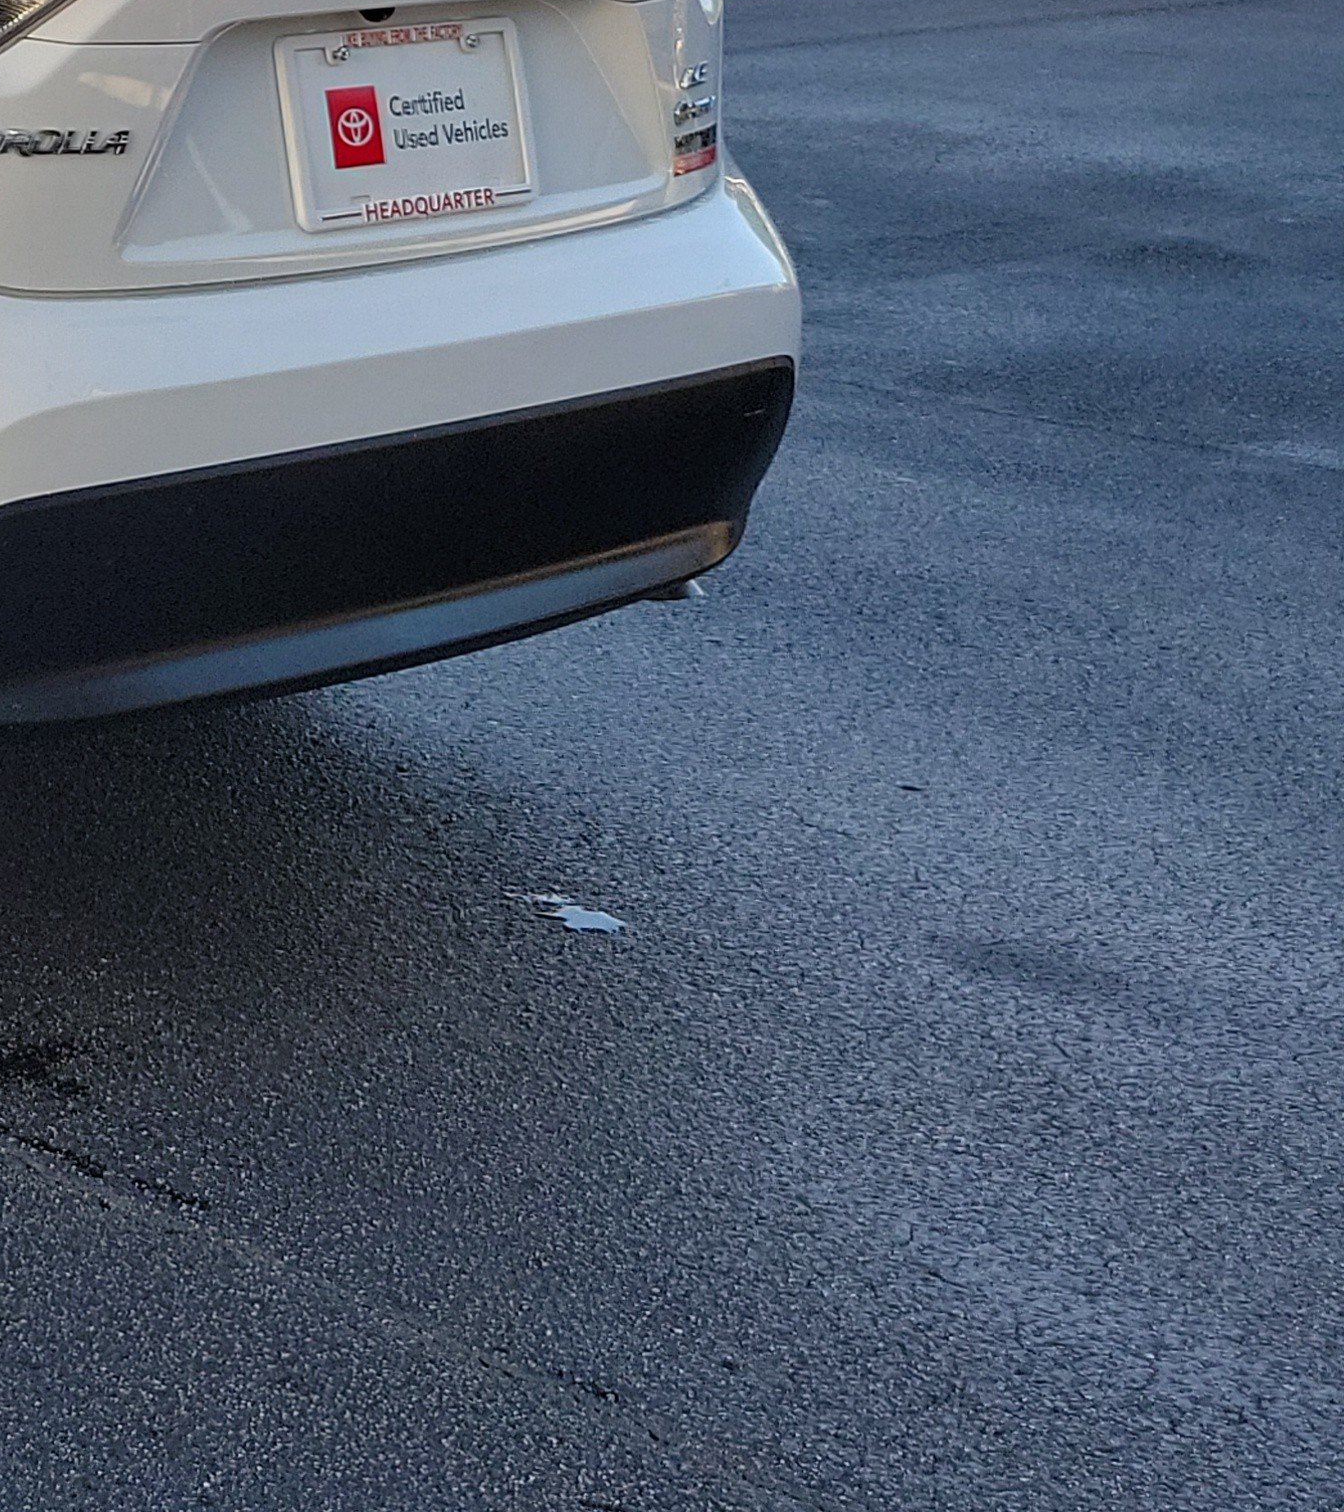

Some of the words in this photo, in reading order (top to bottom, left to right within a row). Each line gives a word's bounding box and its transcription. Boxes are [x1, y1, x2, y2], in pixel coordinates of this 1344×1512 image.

[389, 89, 465, 117] Certified
[393, 125, 439, 150] Used
[442, 118, 509, 144] Vehicles
[365, 188, 495, 222] HEADQUARTER
